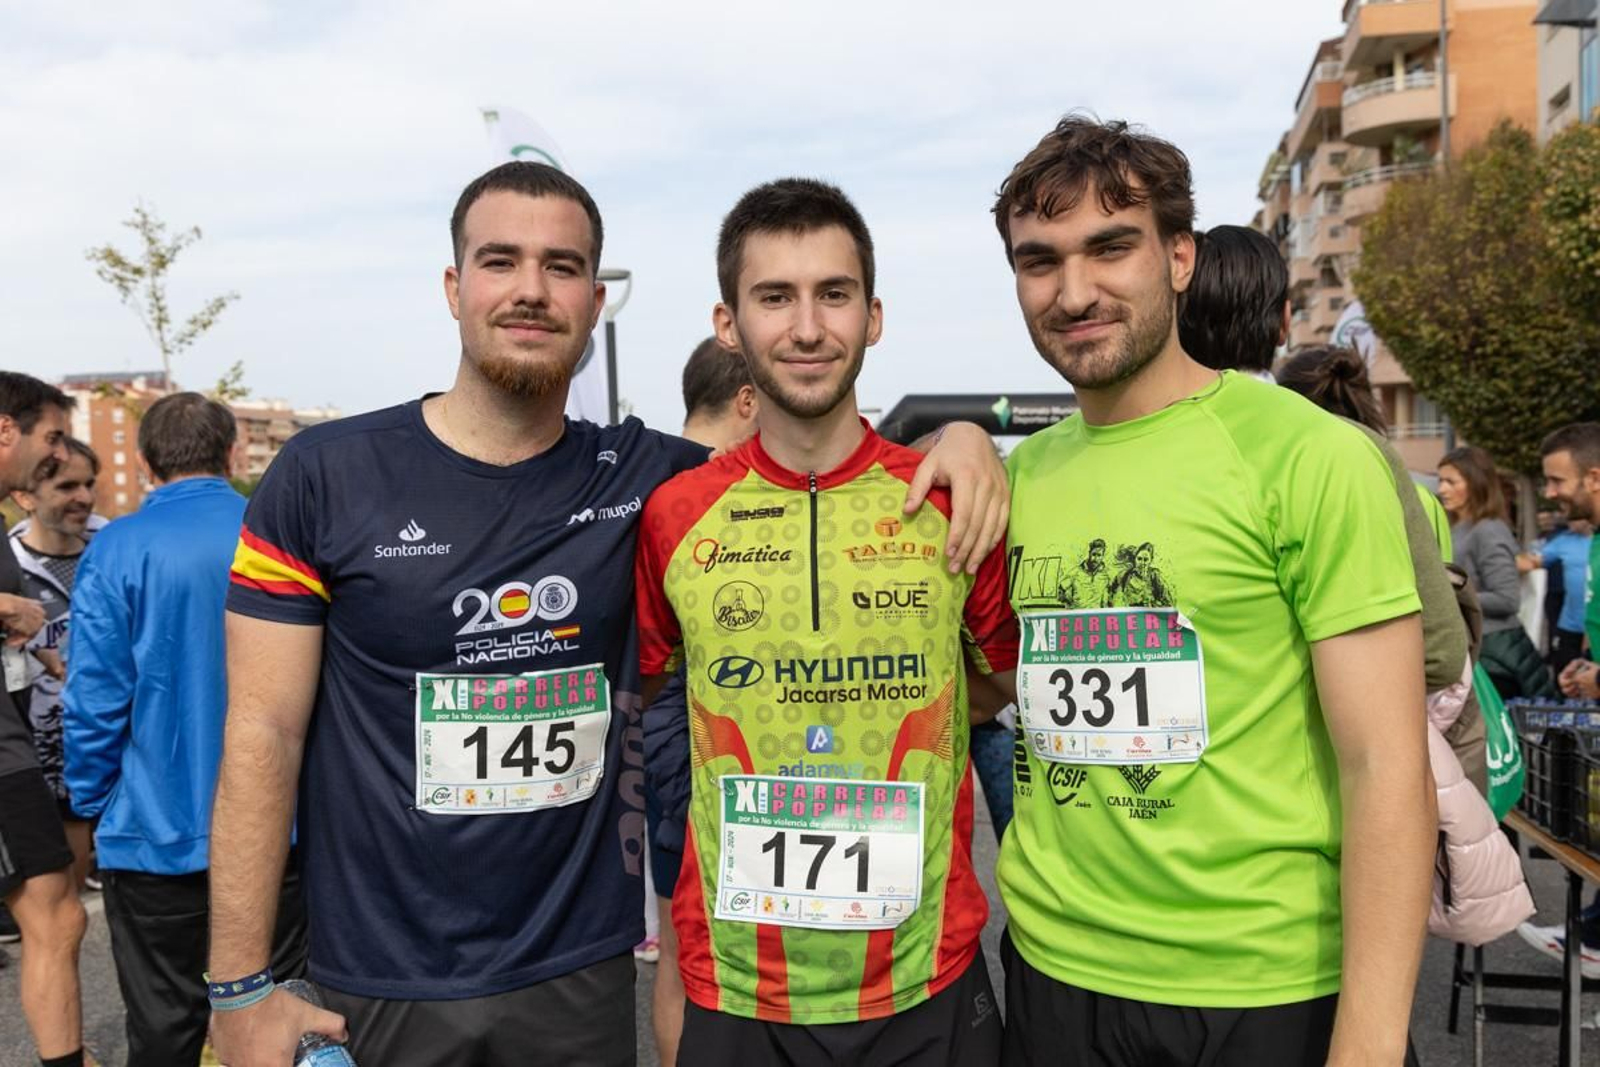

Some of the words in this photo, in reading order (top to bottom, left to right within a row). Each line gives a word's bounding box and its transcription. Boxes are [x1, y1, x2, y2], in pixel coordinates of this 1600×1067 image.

[598, 496, 642, 520] mupol
[374, 542, 452, 558] Santander
[693, 538, 792, 574] Ofimática
[1018, 556, 1061, 600] XI
[452, 575, 578, 636] 200
[875, 590, 928, 609] DUE
[455, 629, 555, 653] POLICIA
[1030, 618, 1056, 652] XI
[1059, 632, 1184, 650] POPULAR
[456, 640, 580, 666] NACIONAL
[1087, 653, 1096, 661] de
[1125, 653, 1131, 661] y
[1133, 652, 1141, 660] la
[1142, 650, 1181, 661] igualdad
[774, 653, 926, 684] HYUNDAI
[432, 679, 468, 710] XI
[473, 670, 596, 694] CARRERA
[472, 687, 596, 710] POPULAR
[776, 686, 861, 704] Jacarsa
[868, 683, 927, 700] Motor
[1049, 667, 1149, 728] 331
[451, 712, 459, 720] la
[461, 712, 473, 720] No
[474, 712, 509, 721] violencia
[511, 713, 522, 721] de
[566, 704, 595, 716] igualdad
[463, 721, 575, 779] 145
[1052, 766, 1088, 789] CSIF
[734, 781, 768, 813] XI
[772, 781, 907, 803] CARRERA
[1107, 795, 1134, 807] CAJA
[1136, 798, 1175, 809] RURAL
[738, 815, 751, 823] por
[752, 815, 760, 823] la
[761, 816, 772, 825] No
[773, 817, 808, 828] violencia
[771, 799, 907, 821] POPULAR
[762, 831, 869, 893] 171
